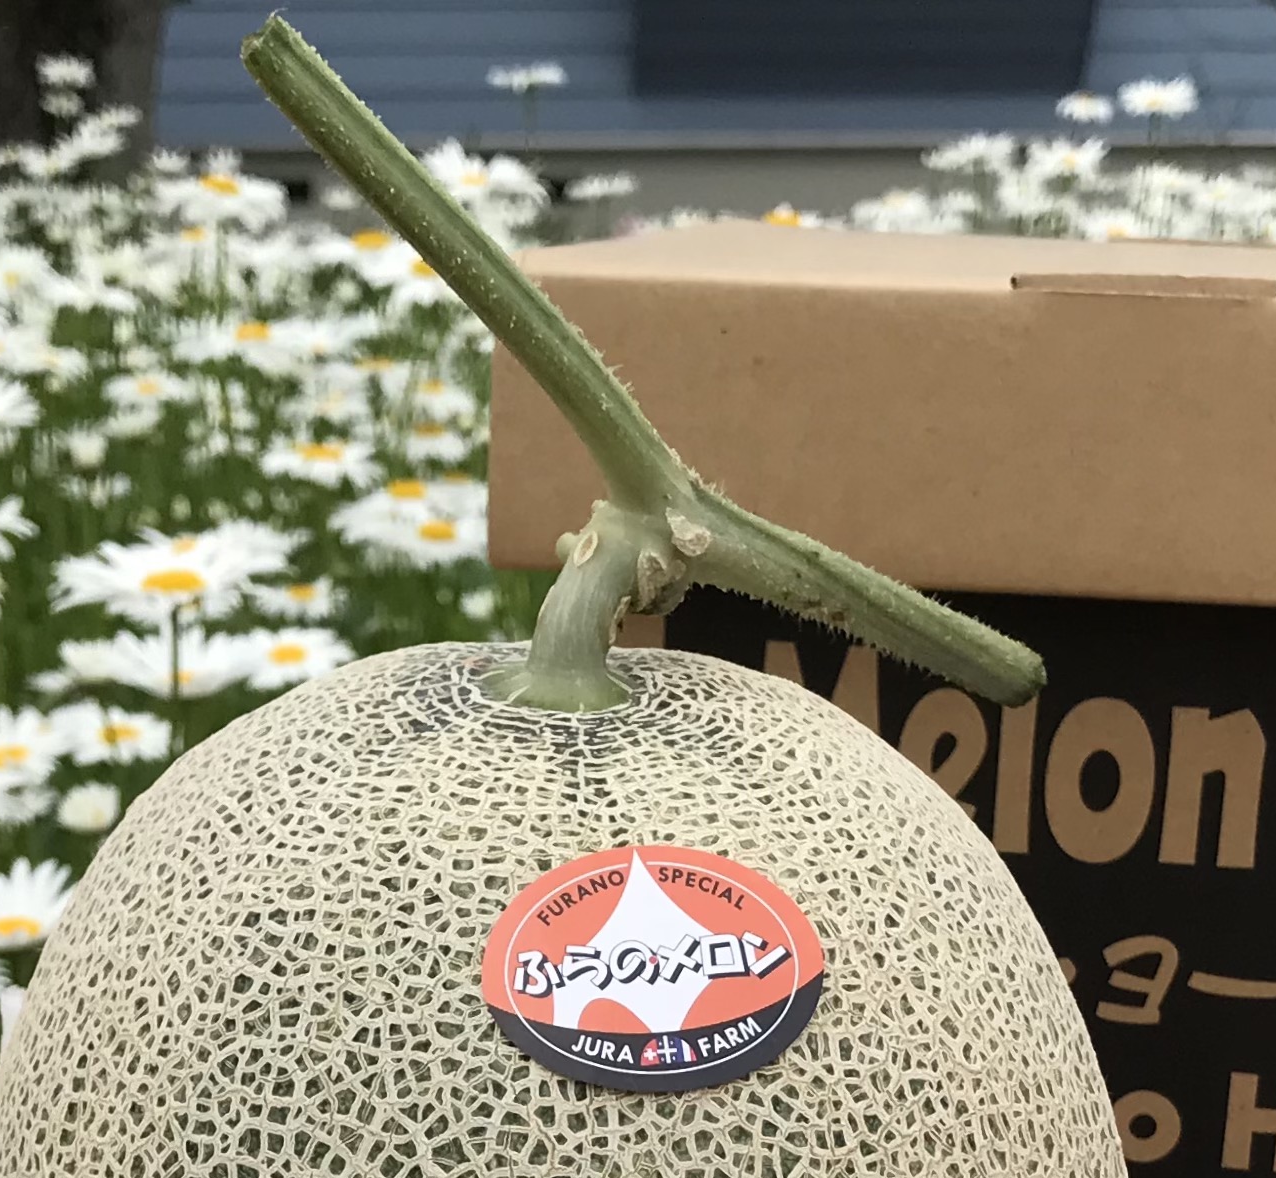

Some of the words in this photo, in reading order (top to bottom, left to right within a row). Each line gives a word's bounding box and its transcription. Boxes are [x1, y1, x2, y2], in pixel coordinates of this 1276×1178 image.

[536, 870, 625, 926] FURANO
[658, 866, 746, 911] SPECIAL
[513, 931, 792, 997] ふらのメロン
[571, 1034, 635, 1064] JURA
[698, 1016, 763, 1057] FARM
